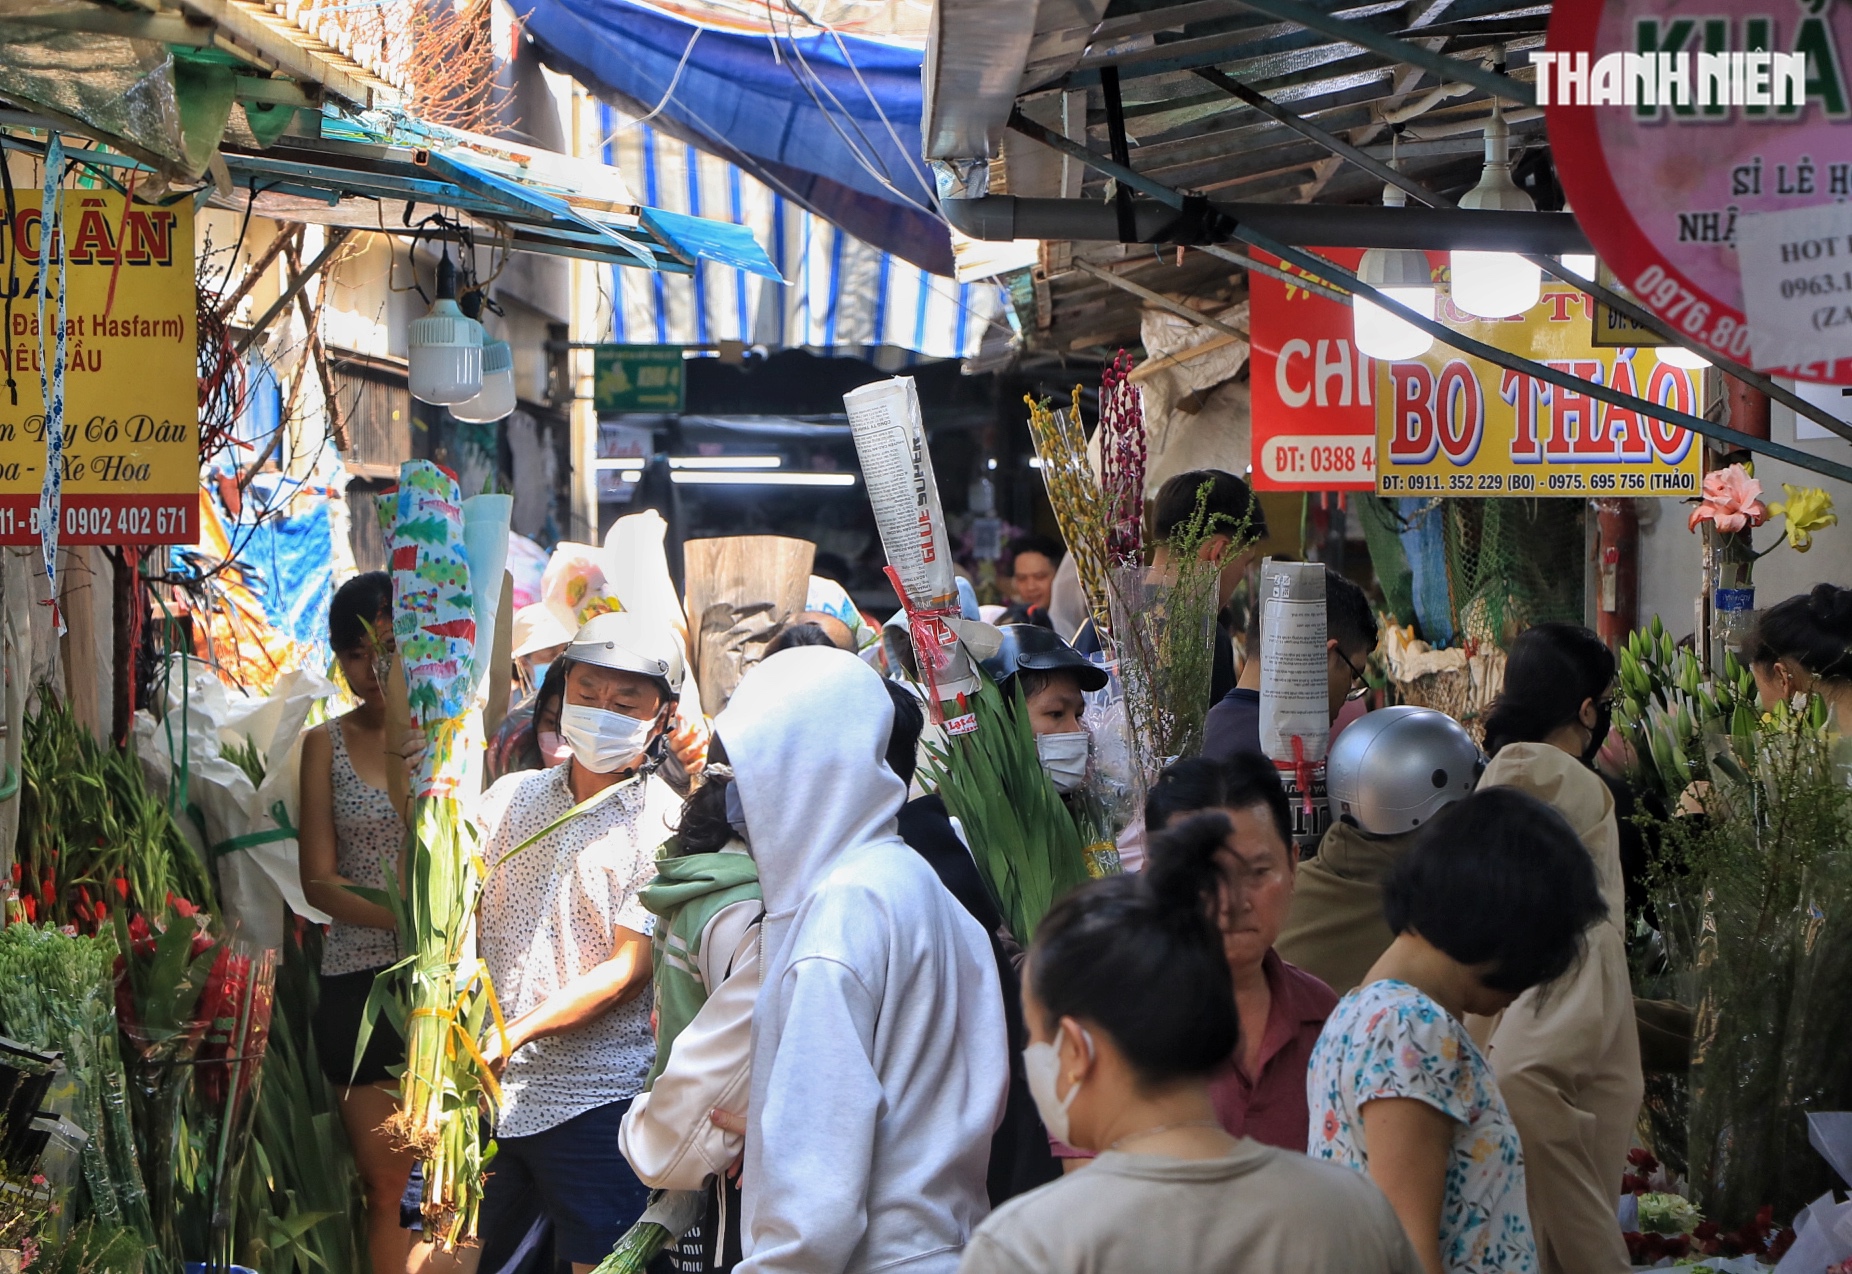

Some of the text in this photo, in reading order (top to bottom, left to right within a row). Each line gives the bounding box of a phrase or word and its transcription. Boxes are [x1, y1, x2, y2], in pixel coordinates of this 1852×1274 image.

[1781, 236, 1839, 263] HOT
[93, 314, 184, 343] Hasfarm)
[1389, 346, 1697, 466] BO THẢO
[23, 414, 78, 449] Ty
[84, 415, 118, 443] Cô
[125, 414, 187, 443] Dâu
[90, 455, 151, 481] Hoa
[1275, 446, 1376, 473] ĐT: 0388 4
[1382, 475, 1404, 490] ĐT:
[1408, 474, 1444, 490] 0911.
[1449, 474, 1473, 490] 352
[1478, 474, 1503, 490] 229
[1507, 474, 1535, 491] (BO)
[1549, 474, 1586, 489] 0975.
[1590, 473, 1615, 489] 695
[1620, 473, 1645, 489] 756
[1650, 467, 1695, 491] (THẢO)
[66, 507, 112, 535] 0902
[118, 507, 151, 535] 402
[156, 507, 187, 535] 671
[918, 508, 936, 564] GLUE
